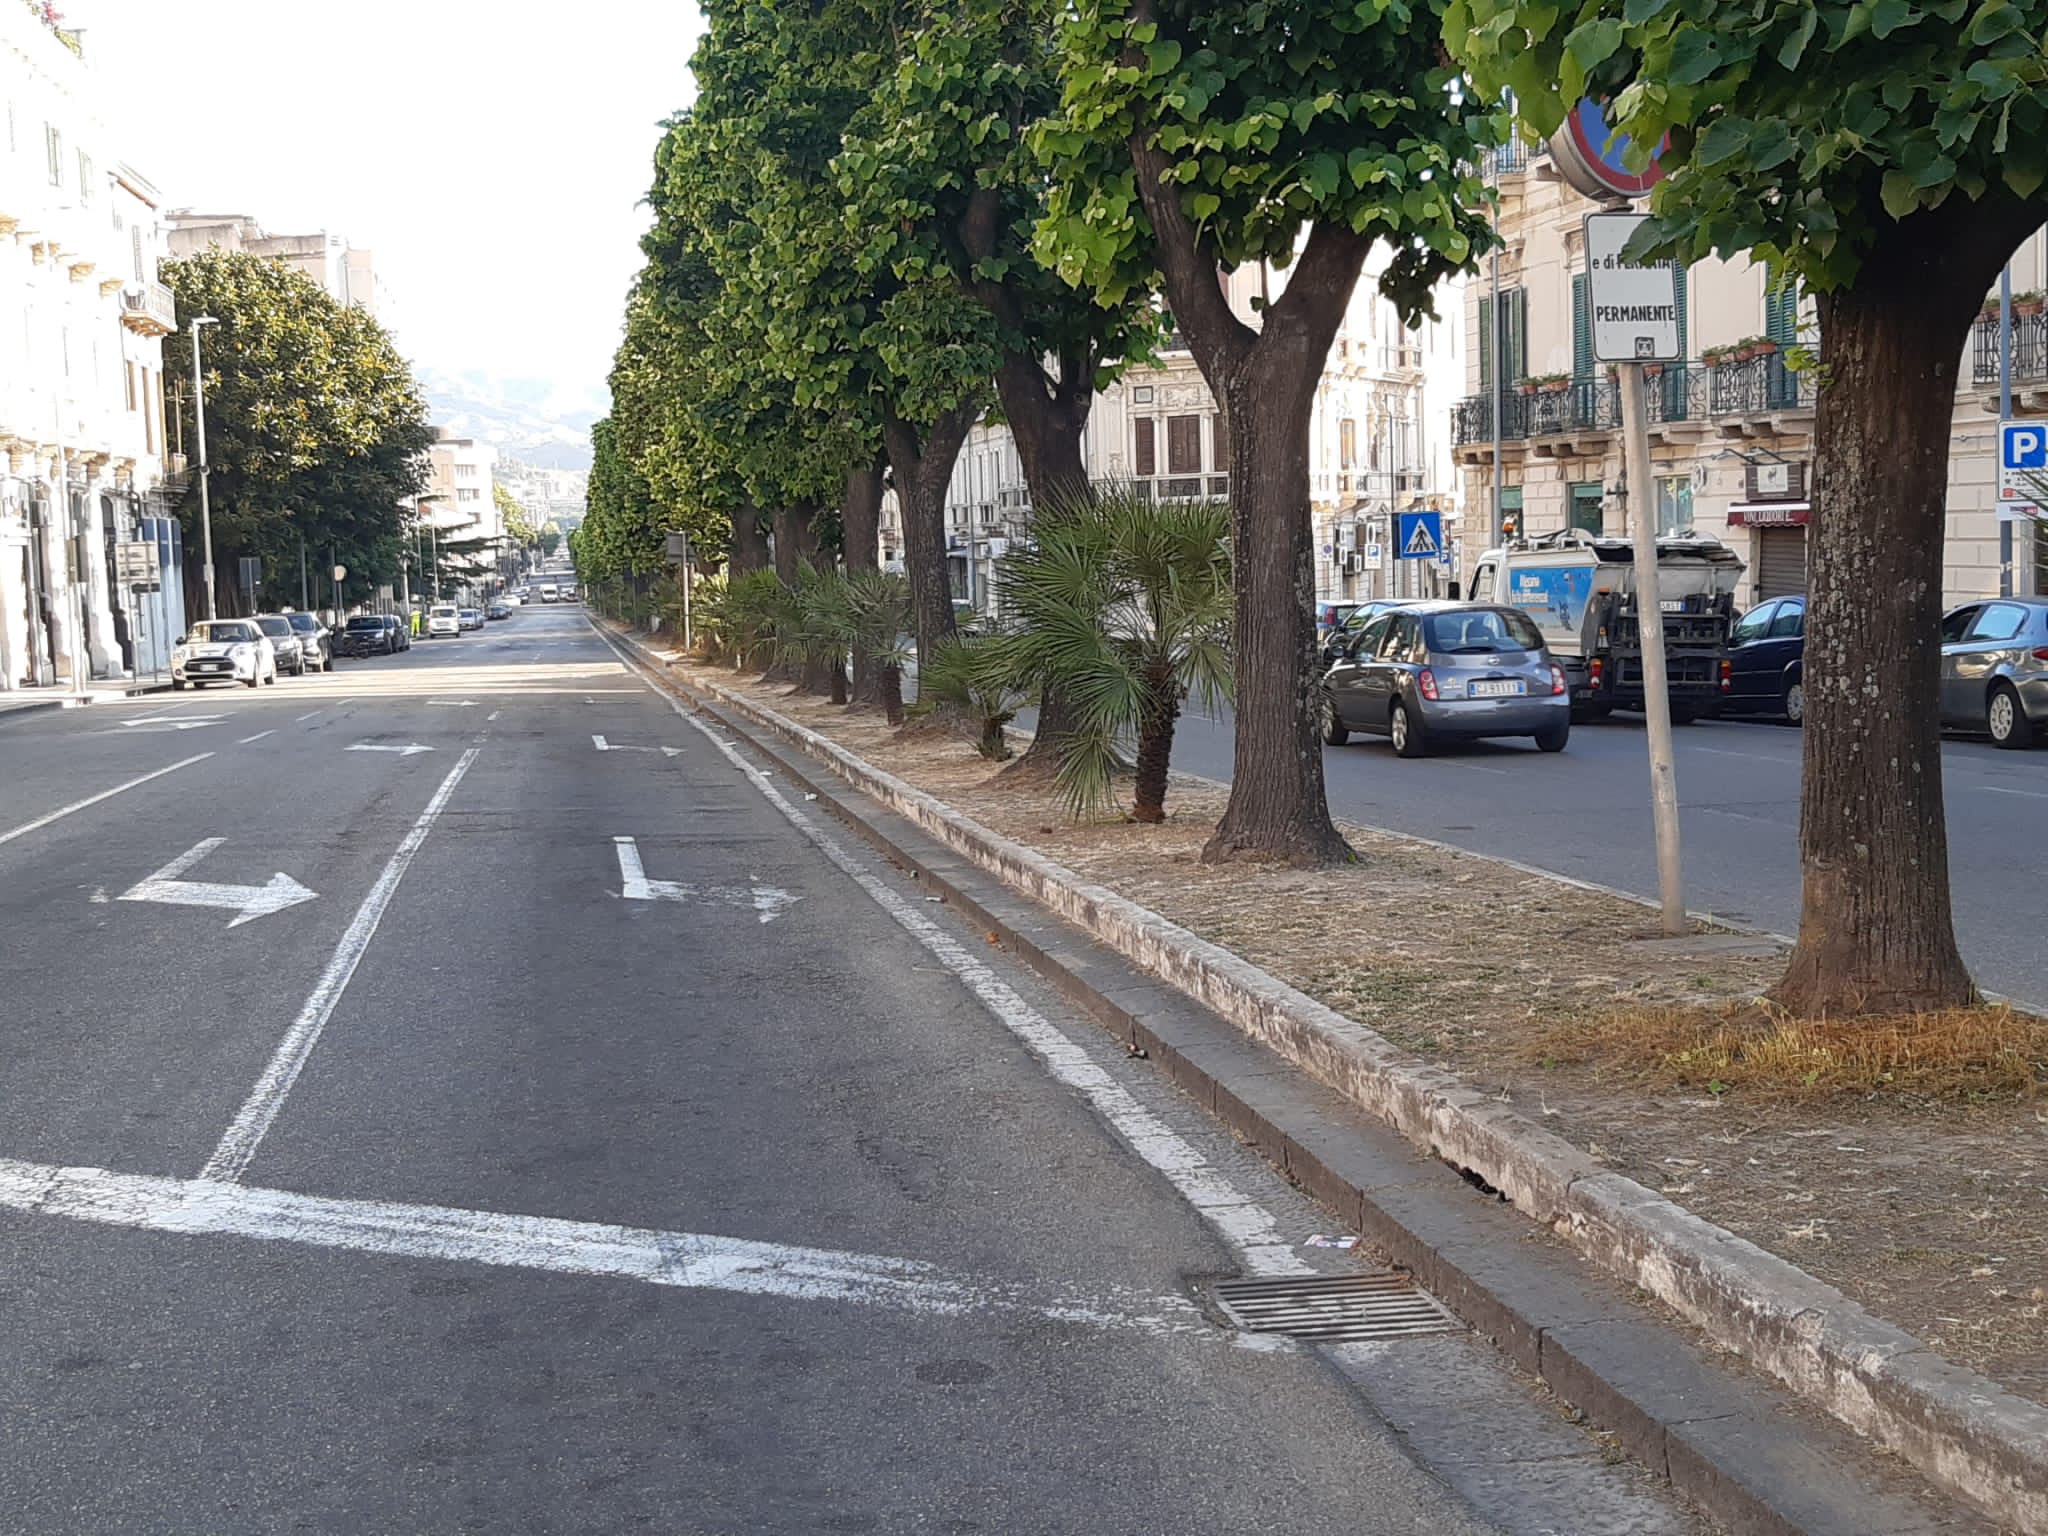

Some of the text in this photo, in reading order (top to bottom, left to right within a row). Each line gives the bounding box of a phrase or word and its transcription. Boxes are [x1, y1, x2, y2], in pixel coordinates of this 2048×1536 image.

[1592, 258, 1600, 269] e
[1603, 254, 1615, 269] di
[1596, 305, 1675, 322] PERMANENTE
[2013, 432, 2038, 464] P
